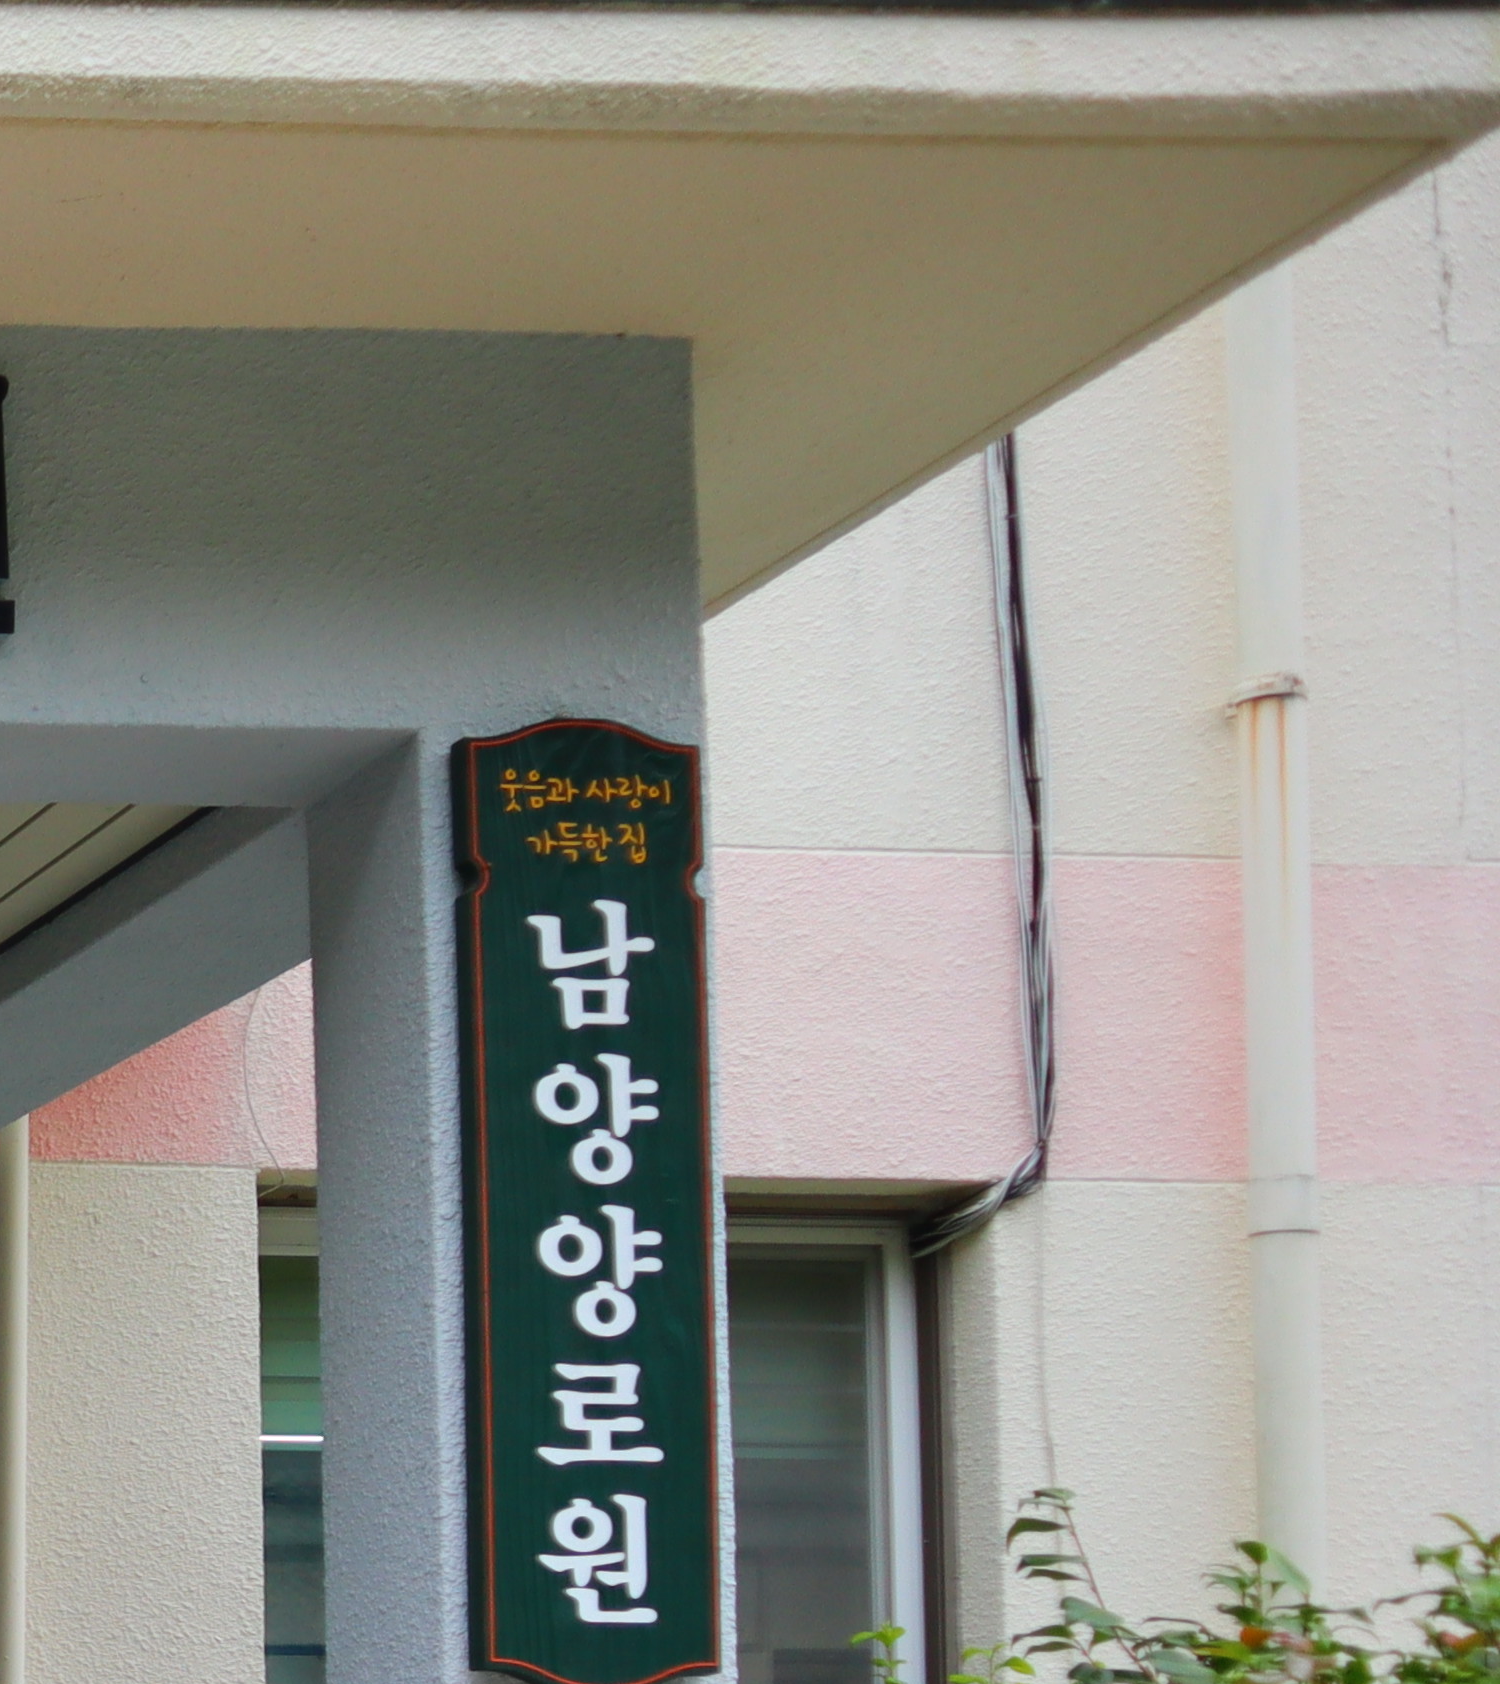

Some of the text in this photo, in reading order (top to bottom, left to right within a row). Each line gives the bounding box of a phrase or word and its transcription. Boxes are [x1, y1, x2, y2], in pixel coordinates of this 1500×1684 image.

[501, 768, 670, 812] 웃음과 사랑이
[526, 822, 647, 864] 가득한 집
[526, 899, 665, 1629] 남양양로원
